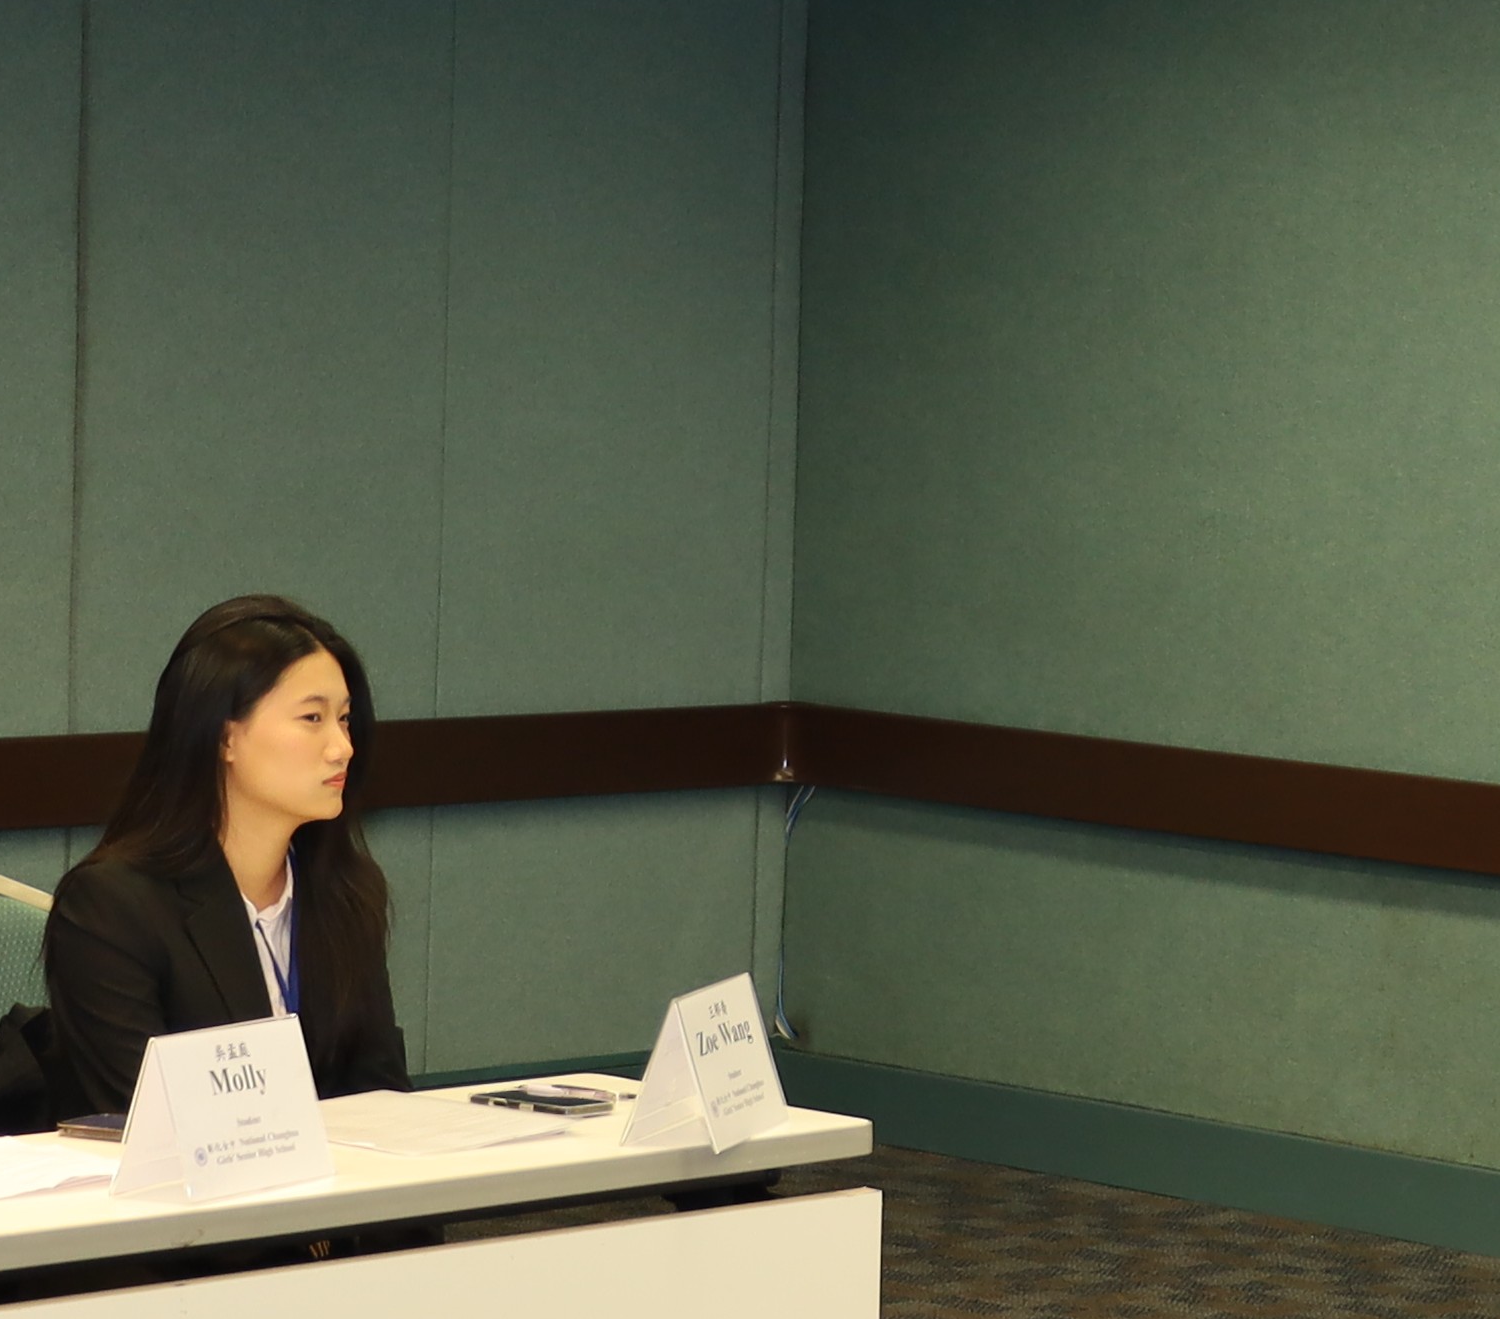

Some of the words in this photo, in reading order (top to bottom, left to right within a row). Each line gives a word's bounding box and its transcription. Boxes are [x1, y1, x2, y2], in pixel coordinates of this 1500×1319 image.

[696, 1031, 720, 1057] Zoe
[718, 1020, 754, 1045] Wang
[208, 1063, 268, 1096] Molly
